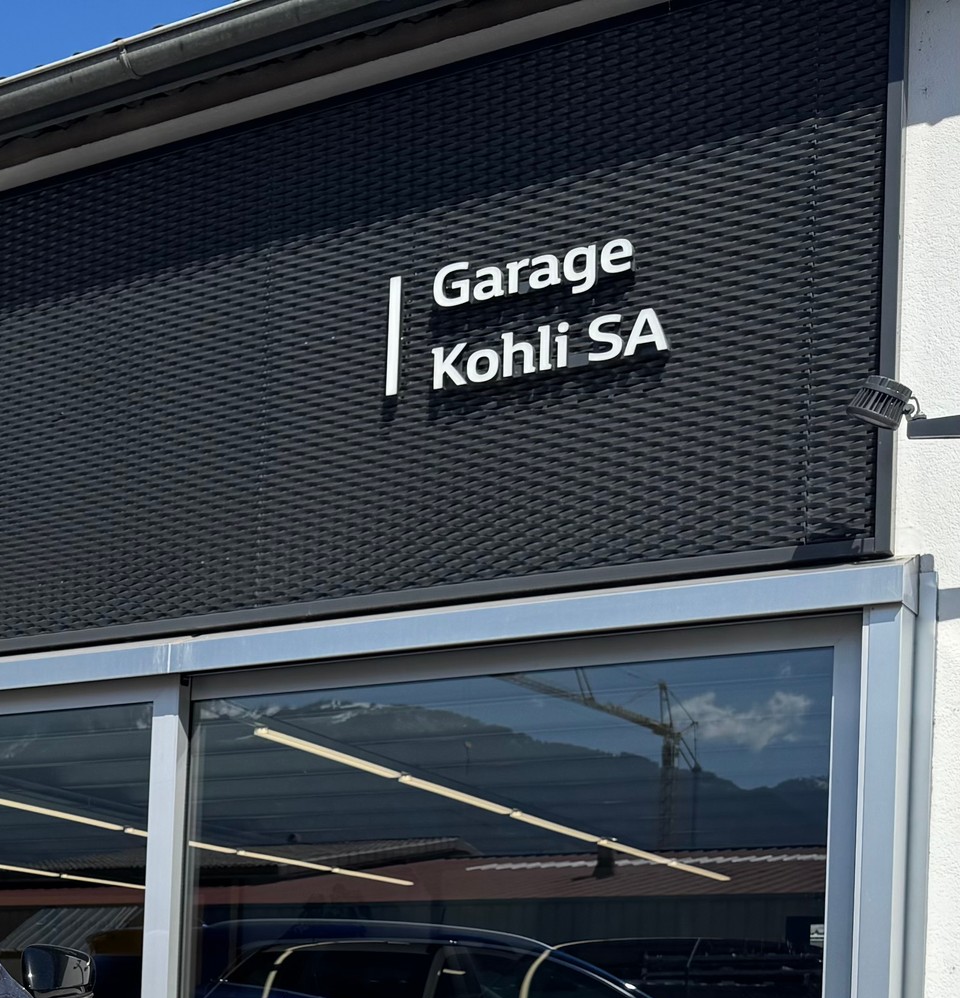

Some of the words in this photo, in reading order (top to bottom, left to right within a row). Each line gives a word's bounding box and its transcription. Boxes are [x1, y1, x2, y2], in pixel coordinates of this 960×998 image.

[433, 238, 634, 308] Garage
[431, 321, 570, 390] Kohli
[588, 307, 669, 362] SA
